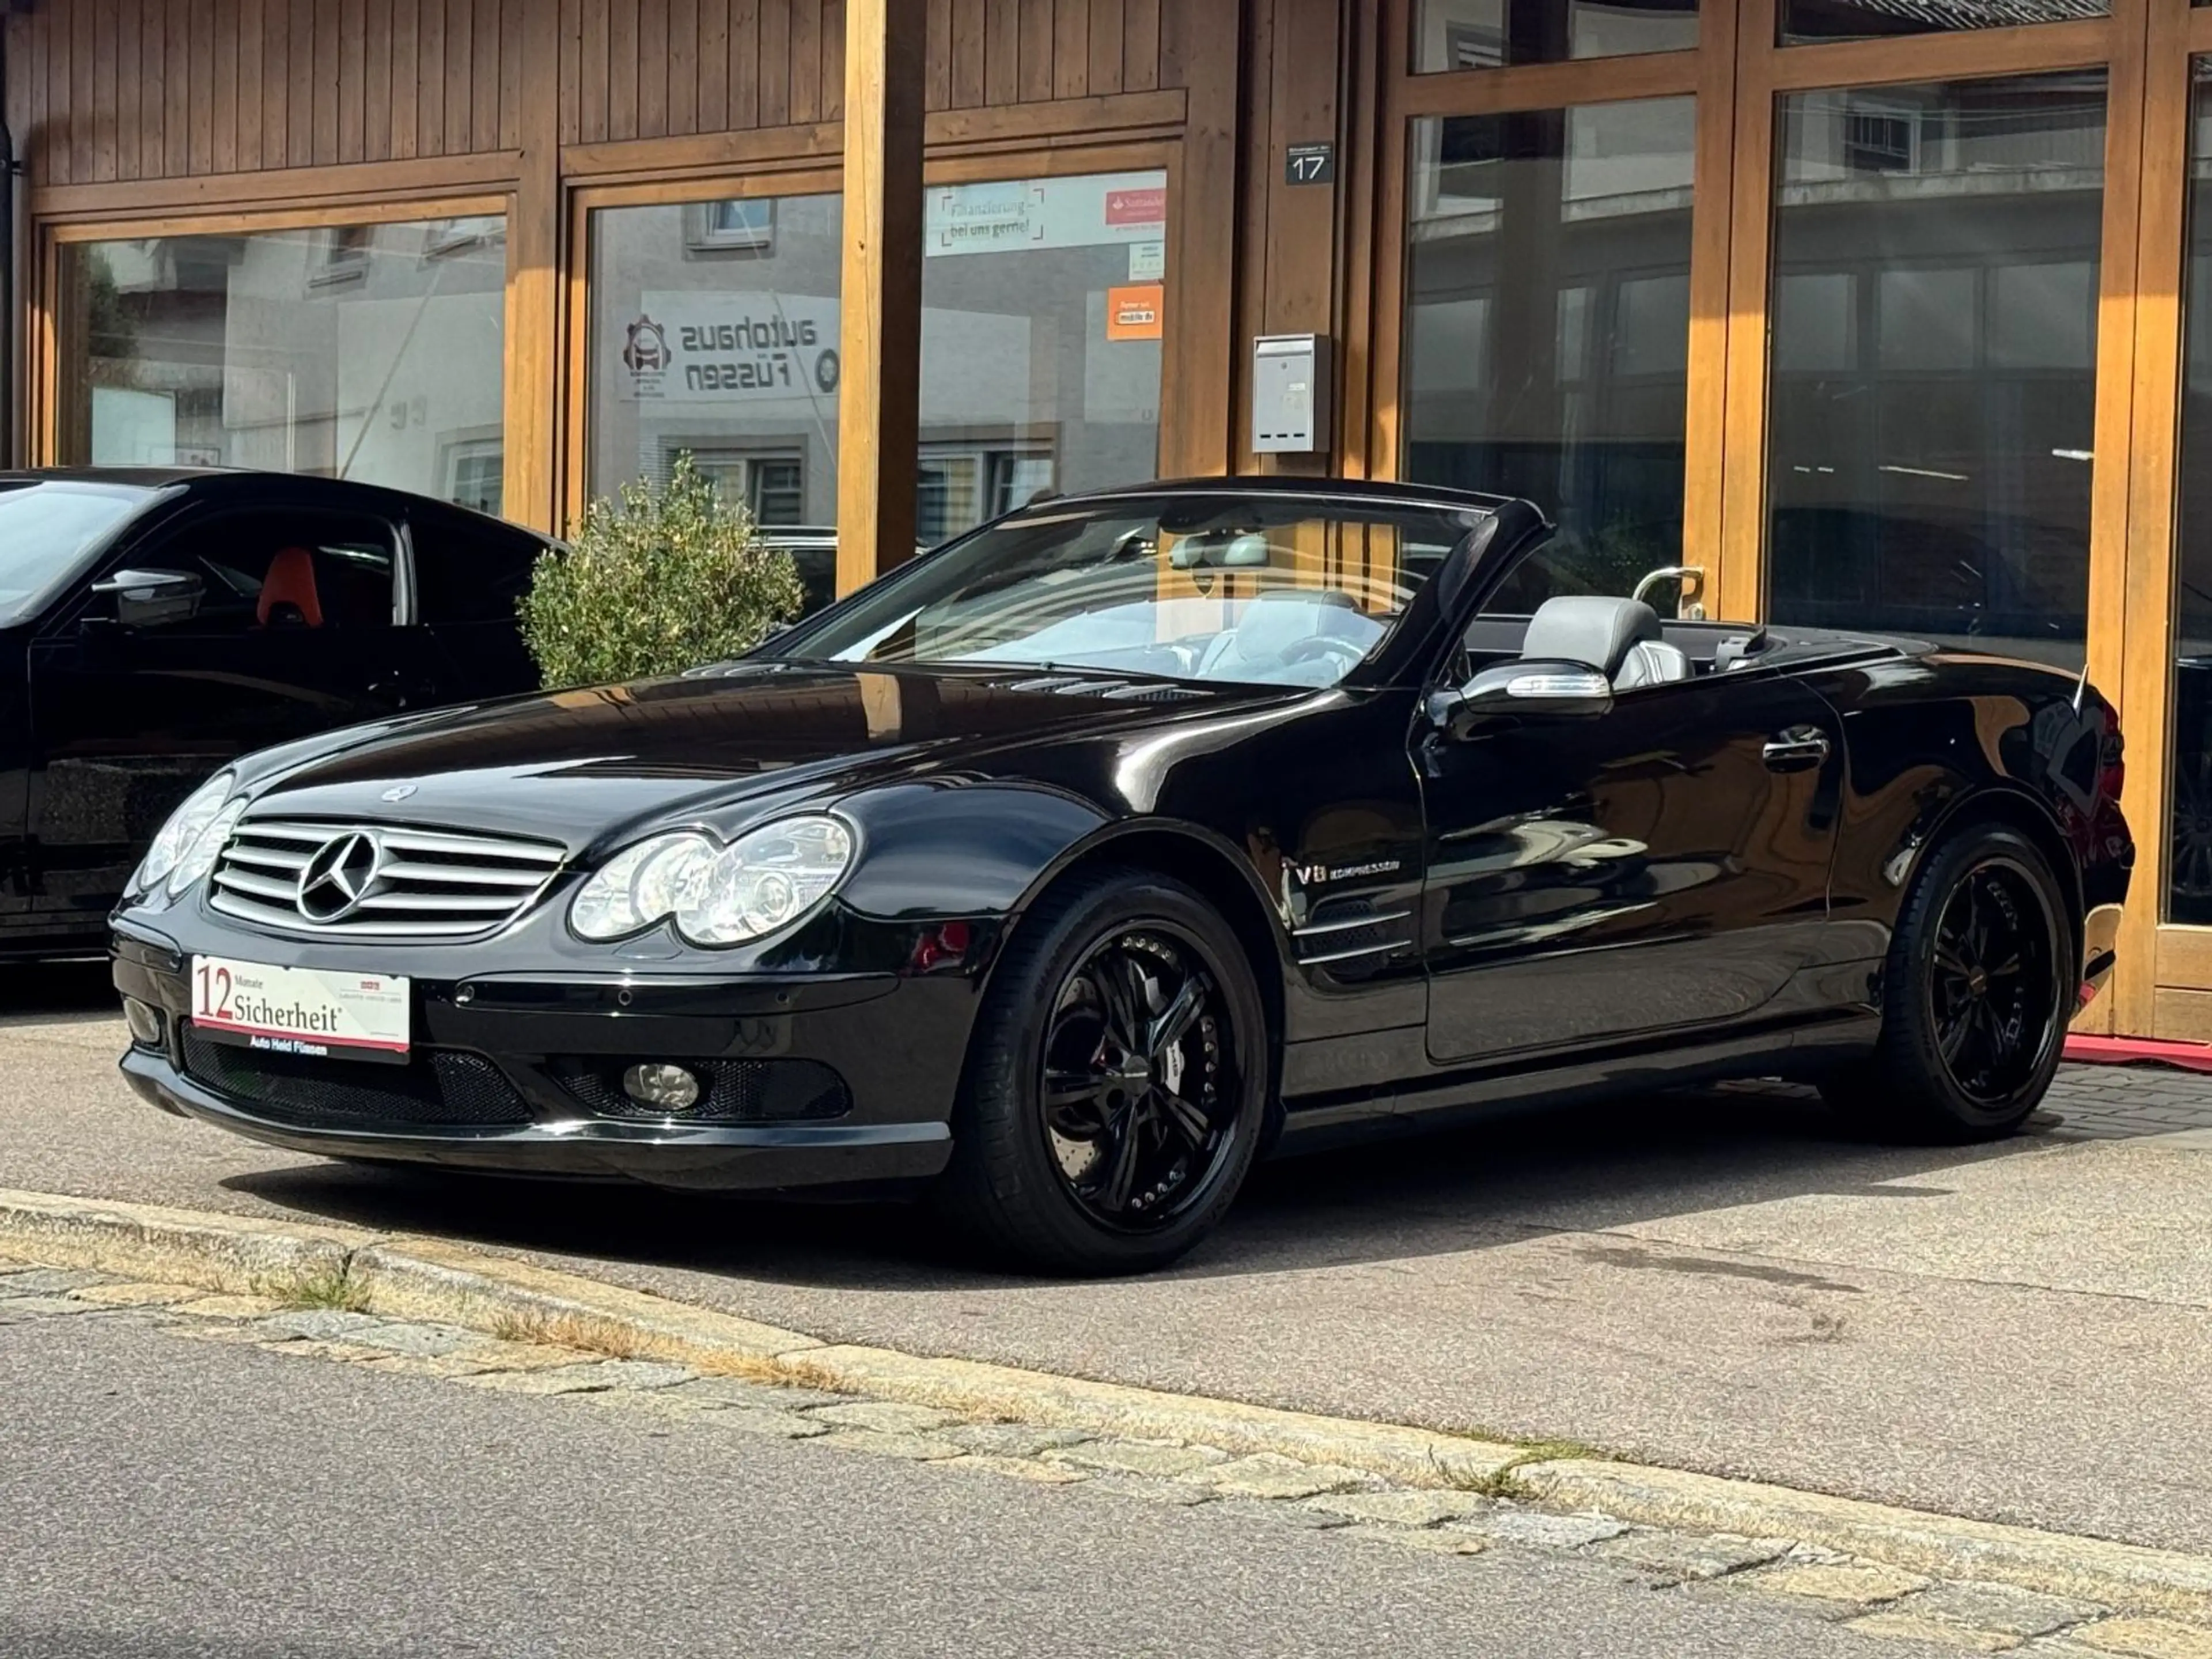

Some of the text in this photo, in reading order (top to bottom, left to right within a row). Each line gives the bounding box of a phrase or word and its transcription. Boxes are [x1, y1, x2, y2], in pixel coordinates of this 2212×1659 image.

[1293, 156, 1324, 180] 17
[950, 217, 1029, 238] bei uns gerne!
[1296, 865, 1327, 885] V8
[197, 963, 233, 1019] 12
[234, 974, 263, 990] Monate
